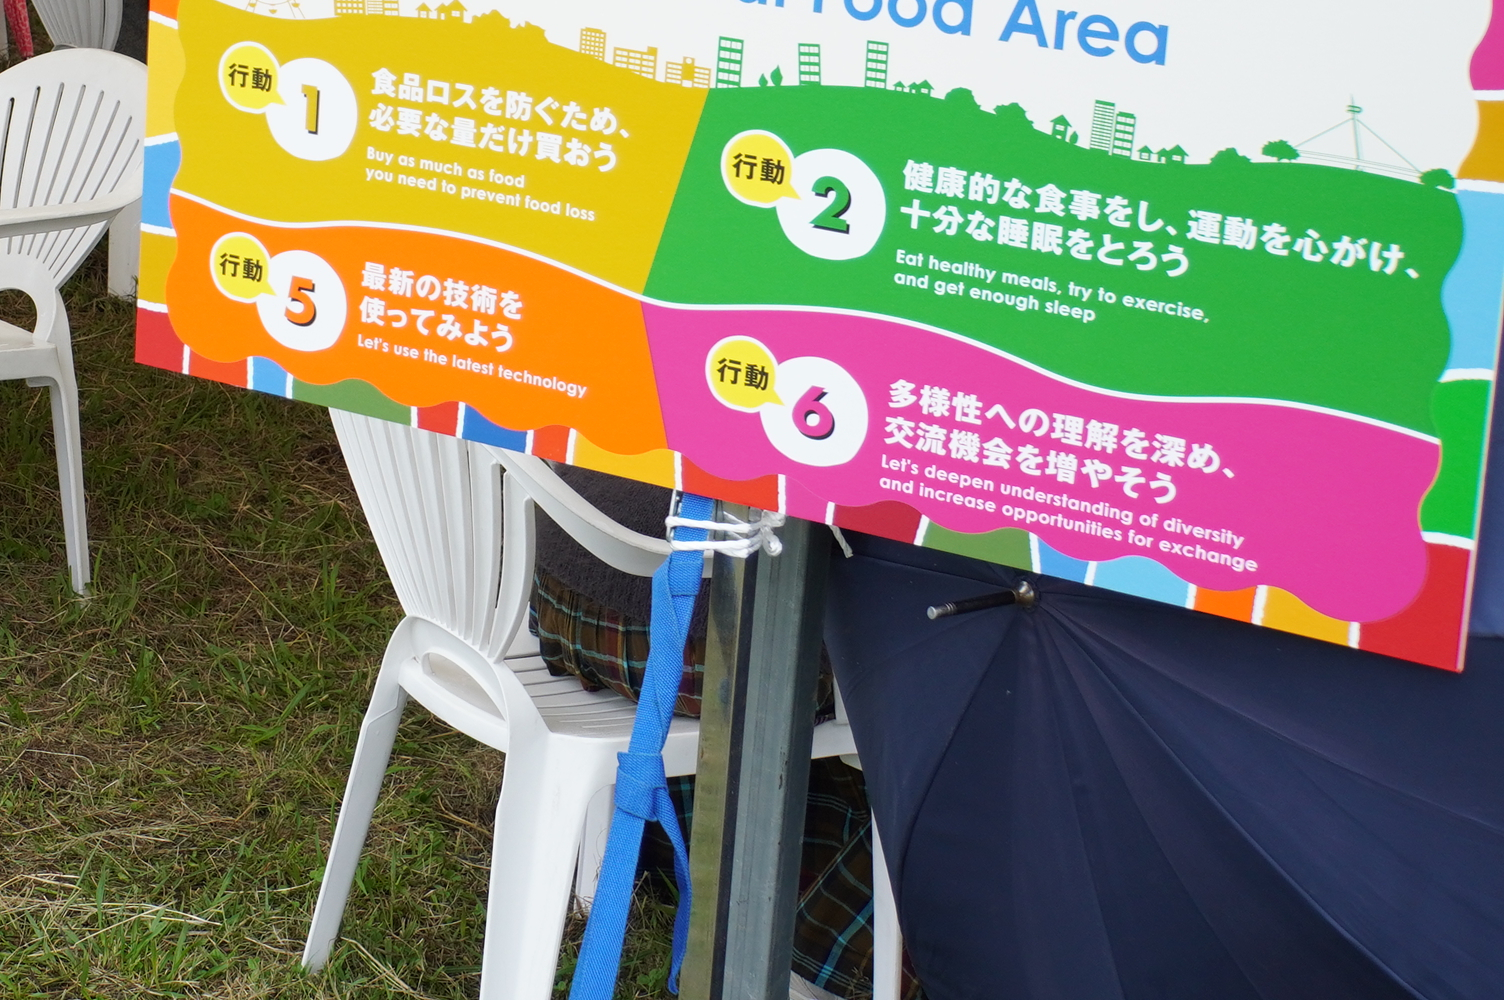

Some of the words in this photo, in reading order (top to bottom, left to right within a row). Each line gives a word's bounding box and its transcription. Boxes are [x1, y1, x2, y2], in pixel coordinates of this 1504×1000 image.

[227, 61, 273, 93] 行動
[370, 66, 631, 138] 食品ロスを防ぐため、
[300, 83, 321, 135] 1
[368, 101, 618, 173] 必要な量だけ買おう
[365, 167, 394, 186] you
[397, 169, 437, 191] need
[440, 178, 458, 194] to
[461, 184, 521, 209] prevent
[524, 191, 562, 215] food
[565, 200, 596, 222] loss
[366, 147, 394, 169] Buy
[397, 154, 416, 168] as
[419, 156, 463, 178] much
[466, 164, 485, 179] as
[488, 165, 525, 188] food
[731, 152, 785, 187] 行動
[808, 175, 853, 235] 2
[903, 159, 1421, 280] 健康的な食事をし、運動を心がけ、
[219, 253, 263, 282] 行動
[900, 201, 1189, 278] 十分な睡眠をとろう
[284, 275, 317, 327] 5
[361, 261, 523, 320] 最新の技術を
[893, 272, 929, 290] and
[934, 278, 964, 297] get
[969, 287, 1039, 312] enough
[1044, 300, 1096, 324] sleep
[895, 249, 923, 268] Eat
[928, 254, 997, 284] healthy
[1001, 271, 1062, 296] meals,
[1068, 281, 1093, 301] try
[1097, 287, 1116, 304] to
[1122, 294, 1210, 324] exercise,
[359, 296, 513, 353] 使ってみよう
[357, 334, 389, 352] Let's
[393, 344, 419, 360] use
[423, 348, 447, 366] the
[452, 354, 494, 376] latest
[498, 365, 587, 399] technology
[717, 357, 769, 391] 行動
[792, 385, 835, 441] 6
[888, 379, 1237, 480] 多様性への理解を深め、
[884, 416, 1176, 504] 交流機会を増やそう
[879, 477, 914, 494] and
[919, 483, 996, 513] increase
[1001, 504, 1123, 542] opportunities
[1128, 529, 1154, 548] for
[1158, 540, 1258, 572] exchange
[881, 454, 919, 475] Let's
[924, 464, 995, 492] deepen
[1000, 483, 1133, 526] understanding
[1139, 513, 1159, 528] of
[1163, 517, 1245, 550] diversity
